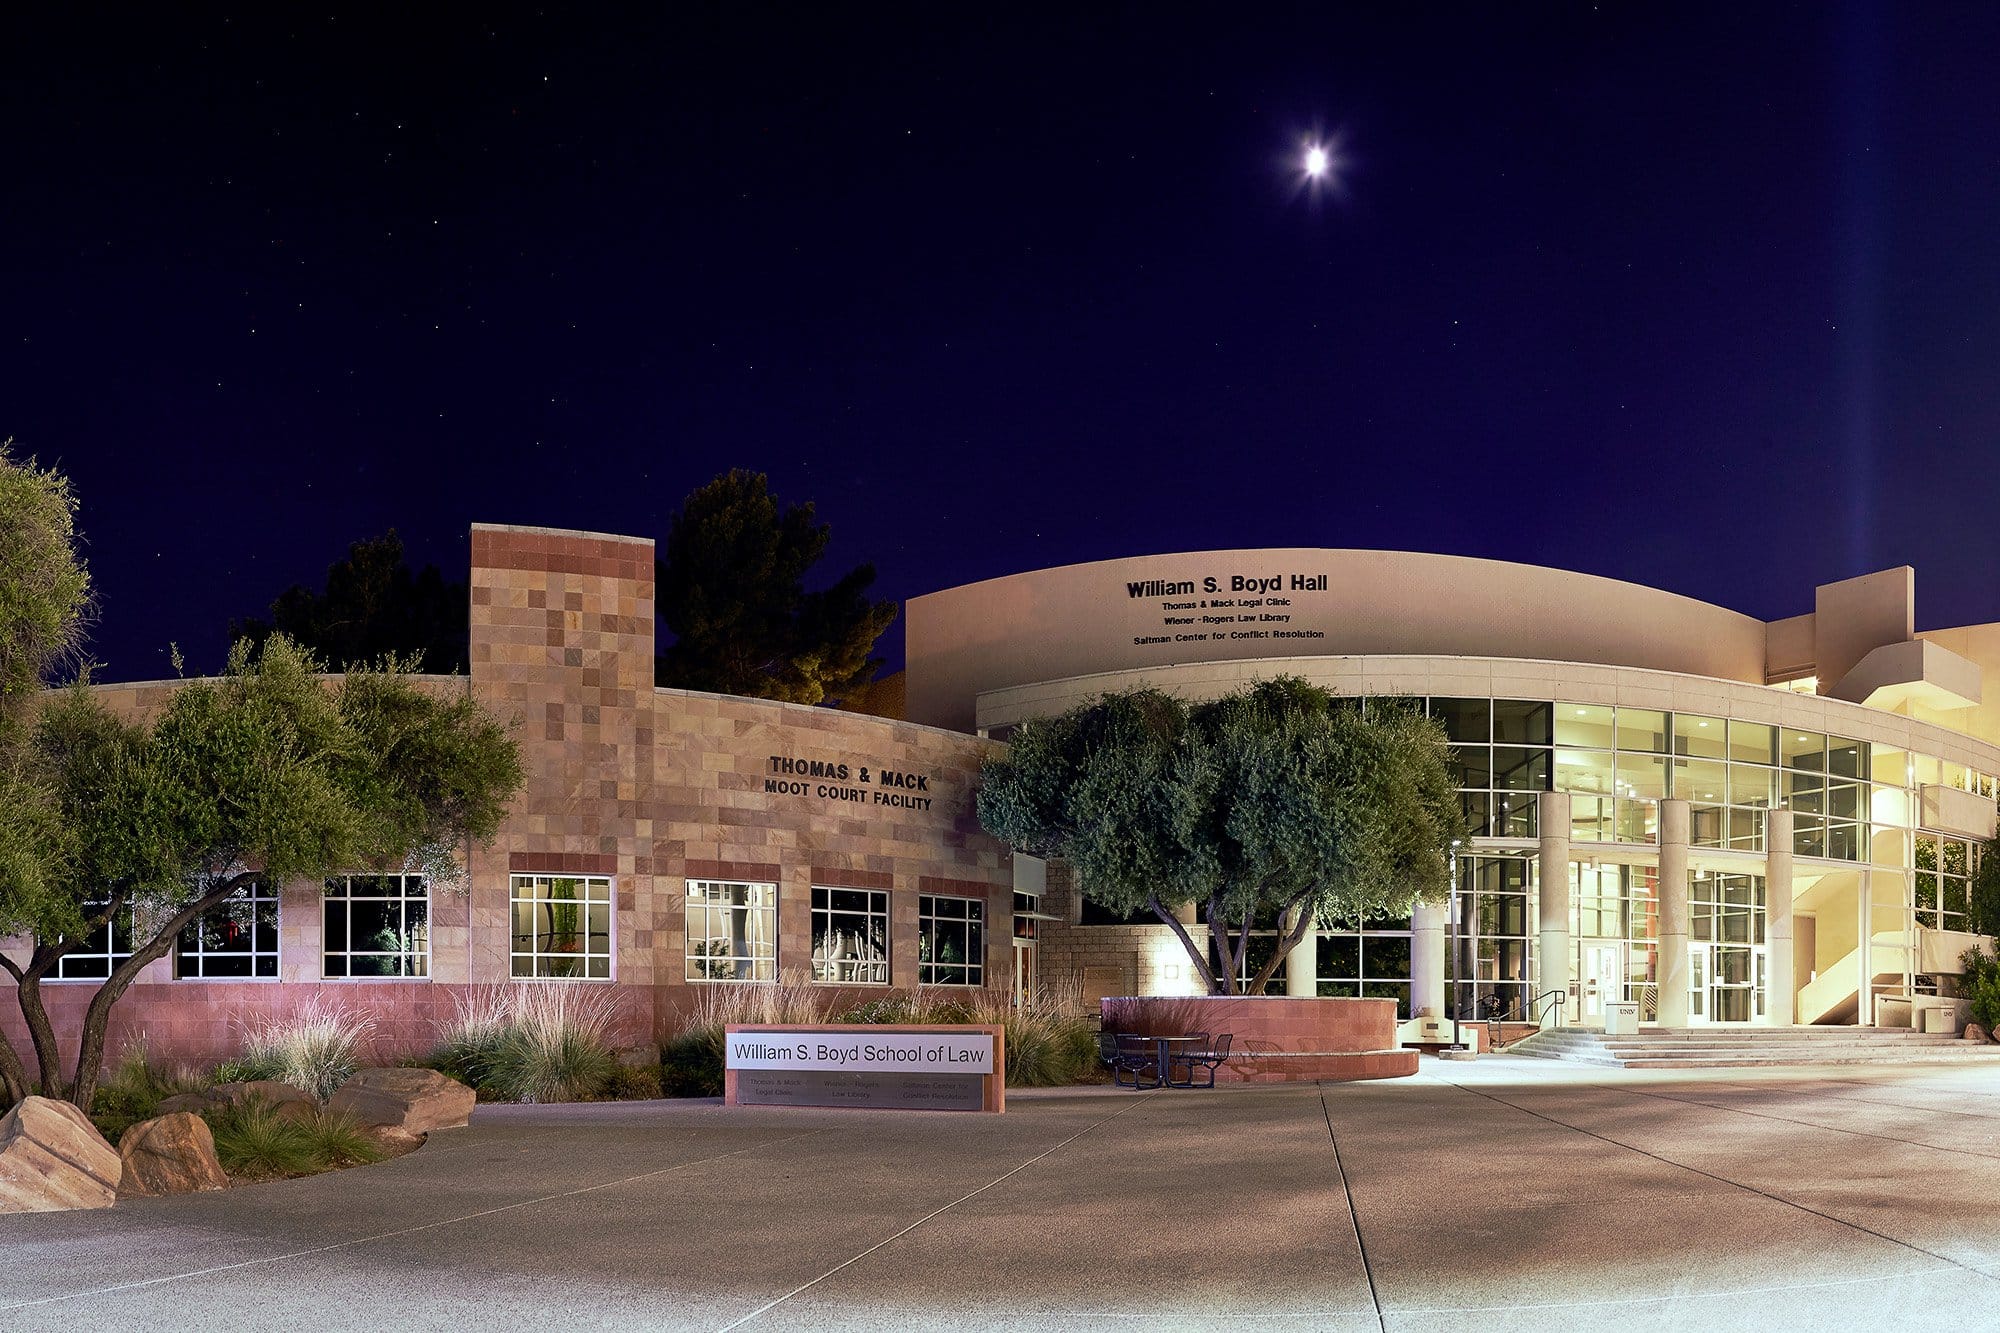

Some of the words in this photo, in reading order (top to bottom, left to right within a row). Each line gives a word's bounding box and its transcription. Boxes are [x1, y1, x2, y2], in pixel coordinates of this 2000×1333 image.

[1127, 581, 1195, 598] William
[1203, 577, 1222, 593] S.
[1231, 575, 1282, 594] Boyd
[1291, 574, 1328, 591] Hall
[1162, 602, 1197, 610] Thomas
[1211, 600, 1235, 608] Mack
[1238, 599, 1263, 608] Legal
[1266, 598, 1291, 606] Clinic
[1164, 616, 1195, 625] Wiener
[1238, 614, 1257, 622] Law
[1260, 614, 1291, 623] Library
[1134, 636, 1172, 645] Saltman
[1175, 633, 1208, 642] Center
[1212, 632, 1226, 640] for
[1231, 630, 1269, 640] Conflict
[1273, 630, 1325, 639] Resolution
[770, 756, 849, 780] THOMAS
[859, 767, 871, 783] &
[881, 770, 928, 791] MACK
[765, 779, 810, 796] MOOT
[817, 785, 867, 803] COURT
[873, 791, 932, 811] FACILITY
[735, 1044, 791, 1060] William
[796, 1044, 811, 1060] S.
[817, 1045, 858, 1064] Boyd
[864, 1045, 921, 1062] School
[926, 1046, 943, 1062] of
[949, 1047, 985, 1063] Law
